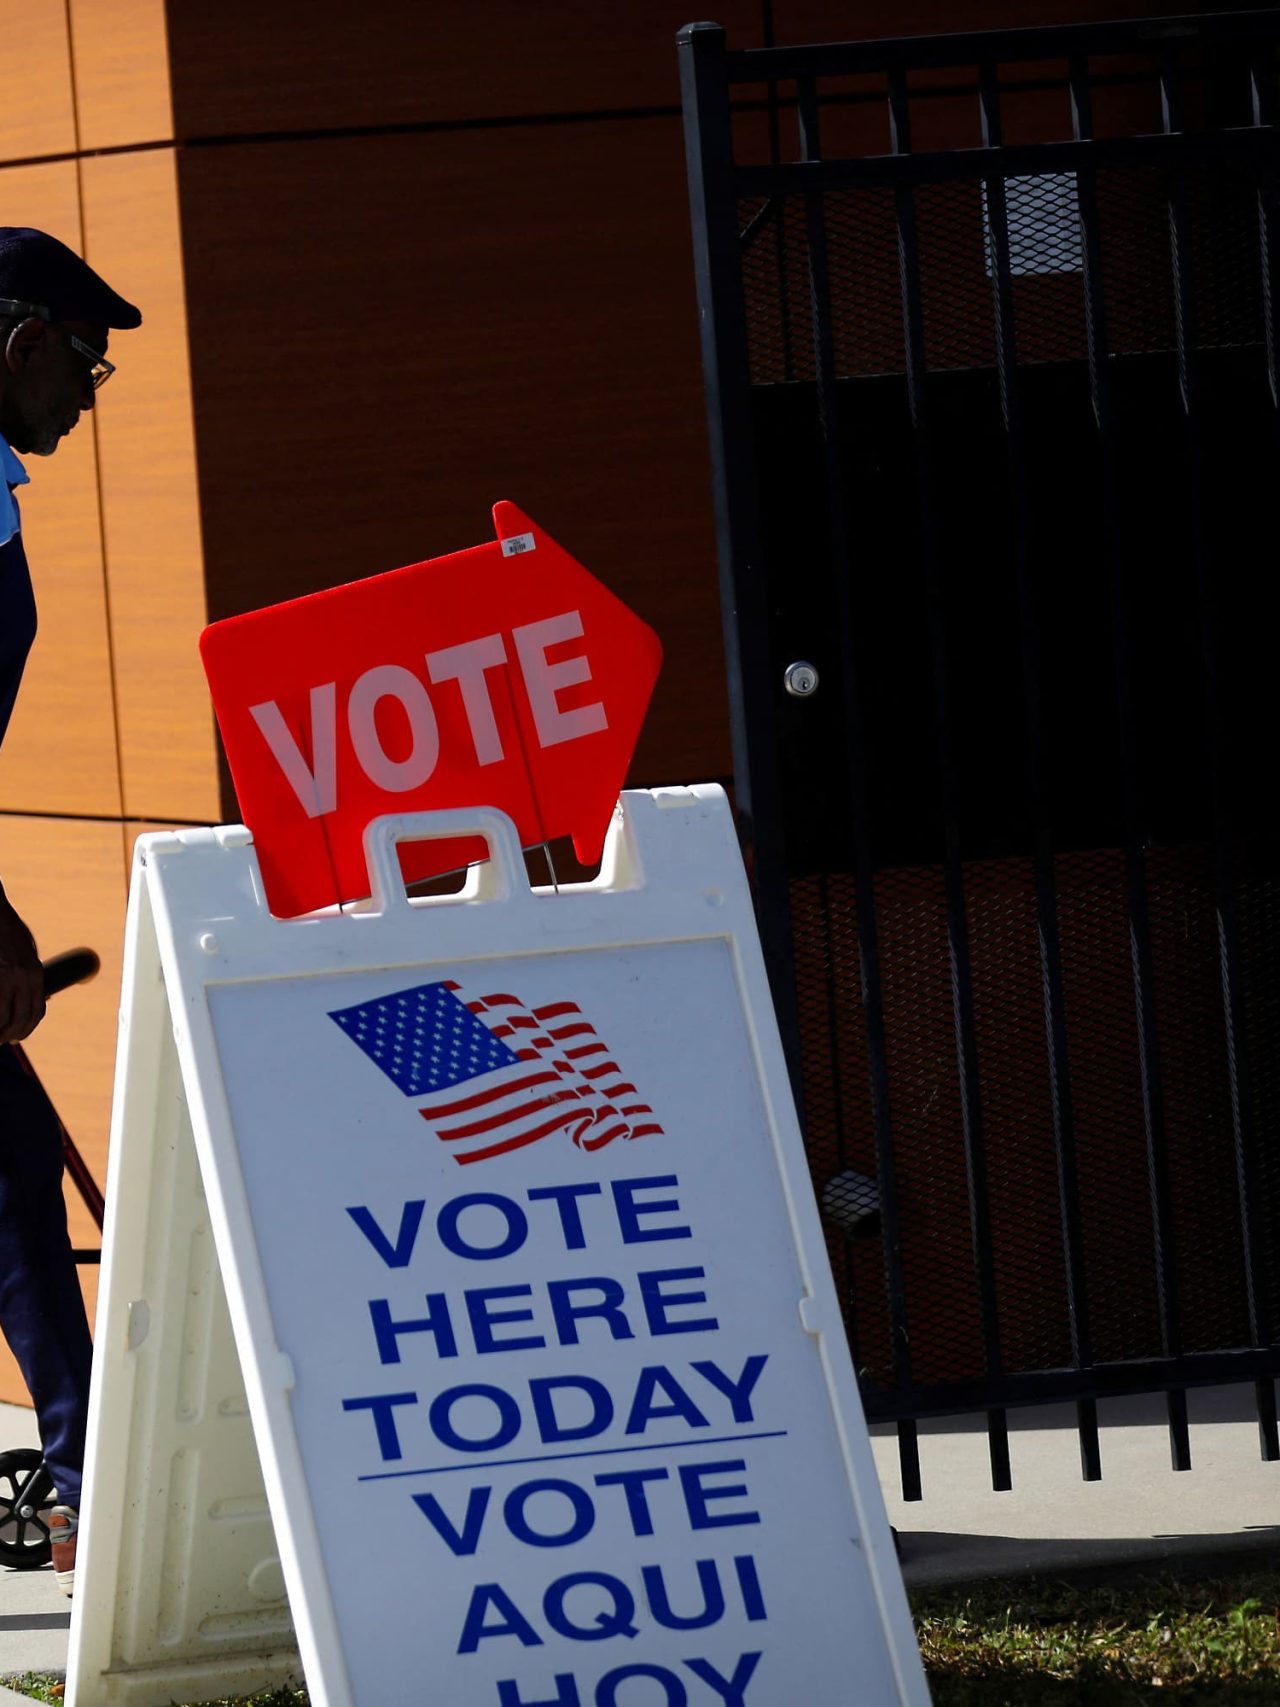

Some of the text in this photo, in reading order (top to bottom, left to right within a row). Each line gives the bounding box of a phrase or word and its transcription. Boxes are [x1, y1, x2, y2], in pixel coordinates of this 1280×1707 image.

[248, 609, 609, 819] VOTE
[345, 1174, 693, 1269] VOTE
[368, 1266, 720, 1365] HERE
[341, 1354, 770, 1461] TODAY
[411, 1458, 762, 1557] VOTE
[457, 1554, 768, 1655] AQUI
